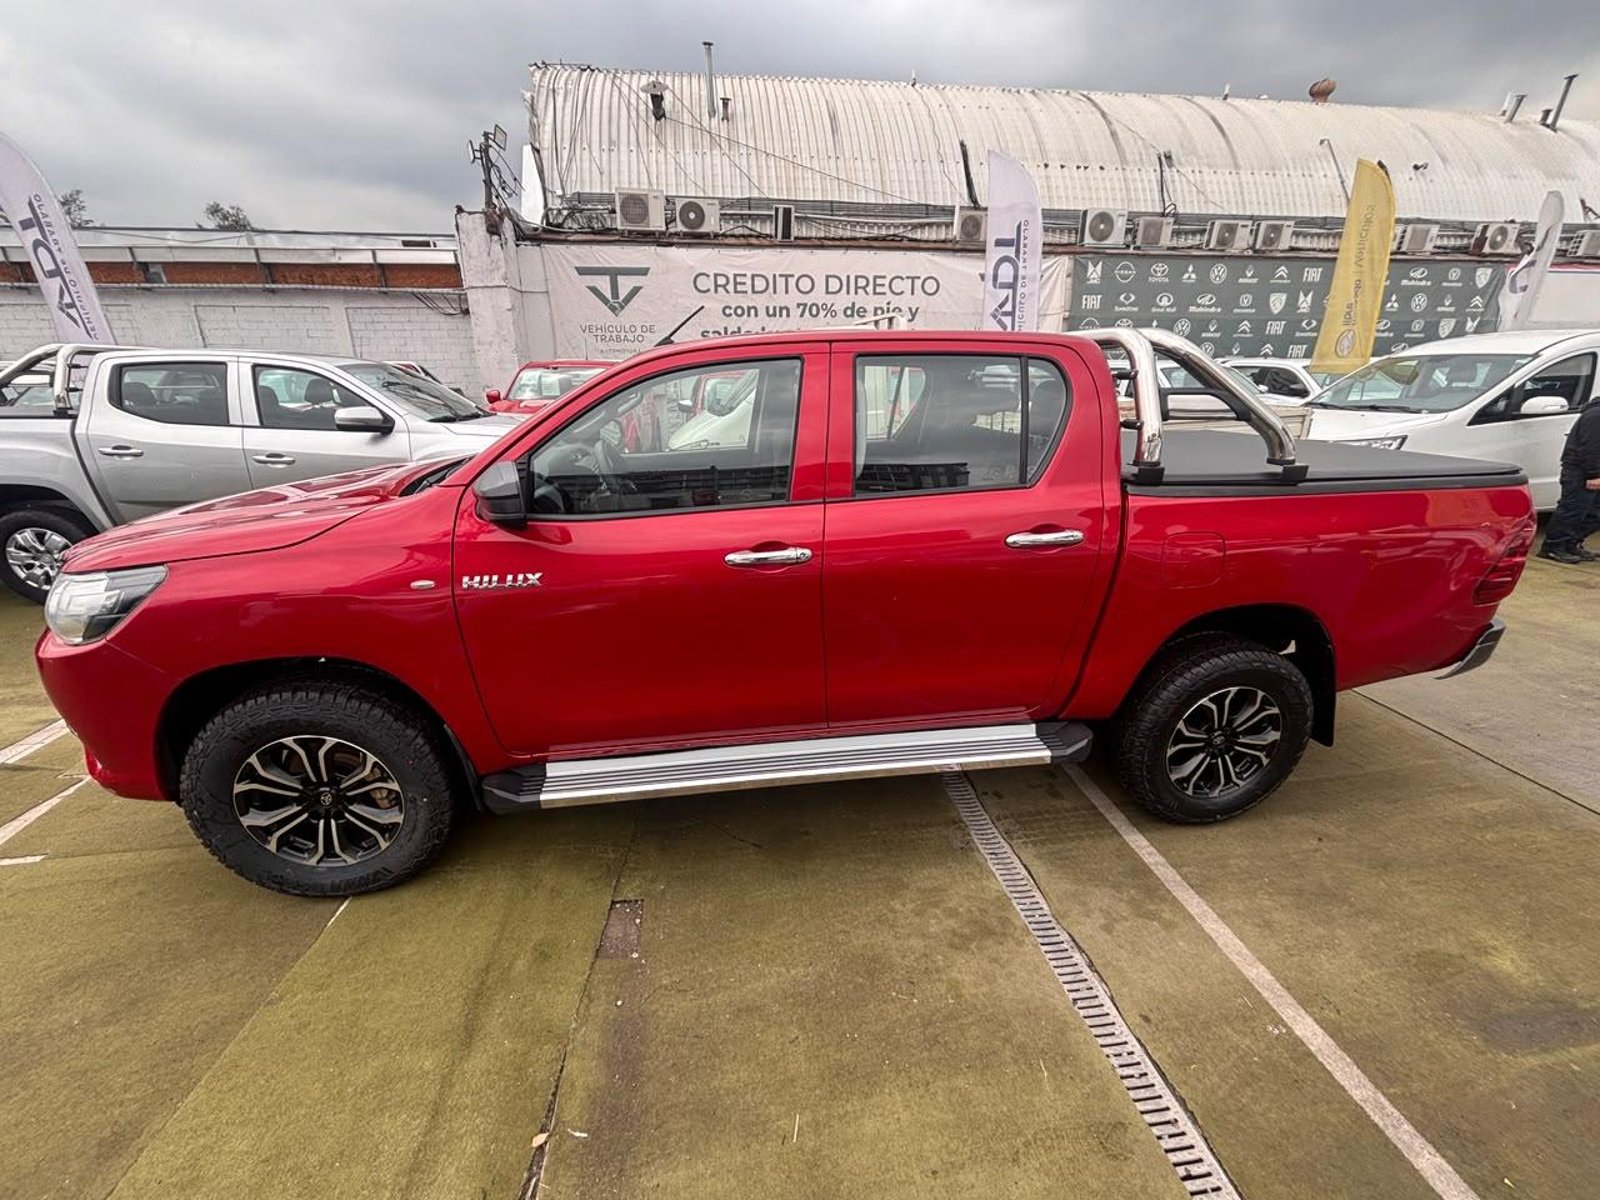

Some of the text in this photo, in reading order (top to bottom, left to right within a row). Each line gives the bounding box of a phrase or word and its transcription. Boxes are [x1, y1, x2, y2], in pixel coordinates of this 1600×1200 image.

[1303, 267, 1324, 282] FIAT
[692, 272, 941, 296] CREDITO DIRECTO
[1081, 294, 1103, 309] FIAT
[722, 305, 759, 319] con
[765, 305, 791, 319] un
[796, 302, 837, 319] 70%
[843, 302, 868, 319] de
[907, 306, 920, 322] y
[580, 322, 656, 334] VEHÍCULO DE
[1265, 321, 1286, 335] FIAT
[593, 334, 645, 343] TRABAJO
[1287, 344, 1308, 359] FIAT
[462, 572, 544, 589] HILUX
